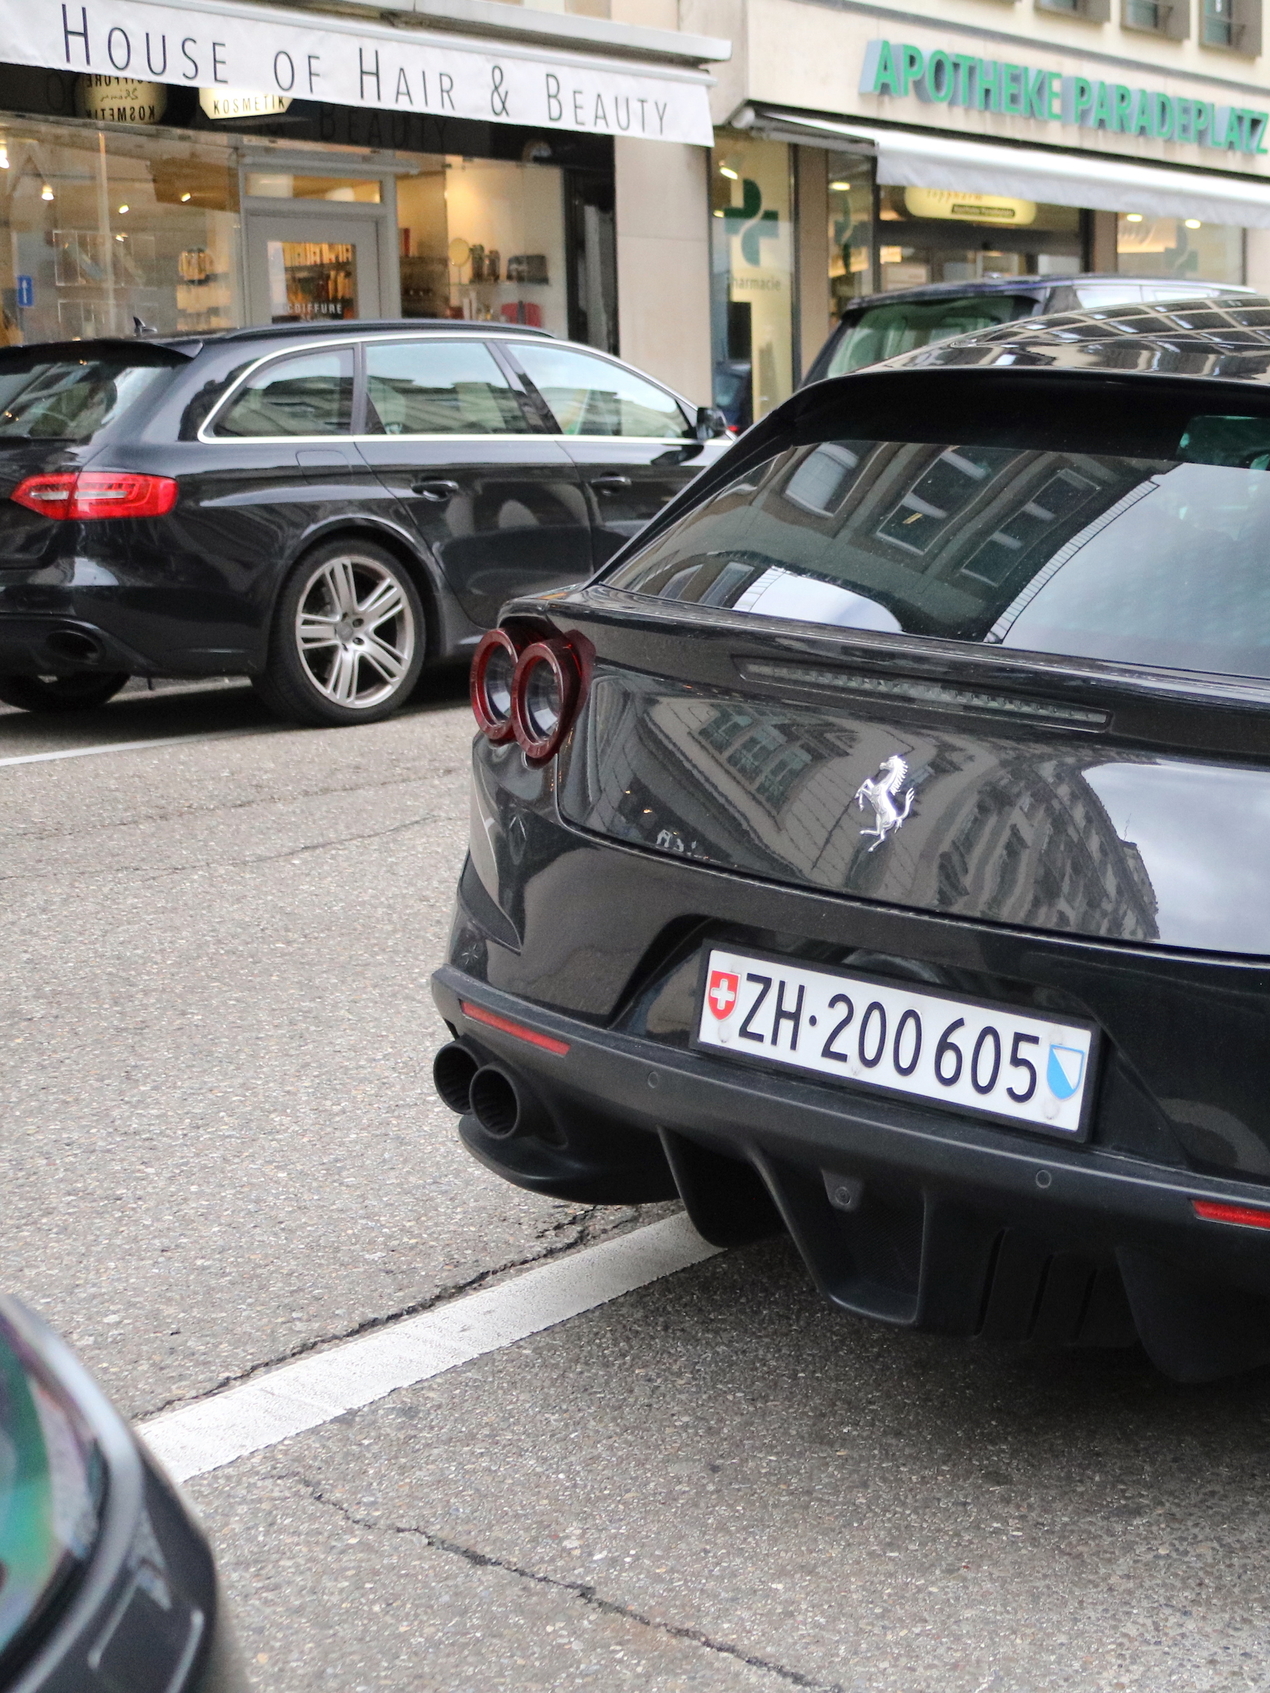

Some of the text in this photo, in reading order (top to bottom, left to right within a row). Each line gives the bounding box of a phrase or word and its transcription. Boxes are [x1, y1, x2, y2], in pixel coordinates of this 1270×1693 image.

[61, 3, 668, 136] HOUSE OF HAIR & BEAUTY
[868, 39, 1270, 155] APOTHEKE PARADEPLATZ
[212, 95, 286, 116] KOSMETIK
[287, 302, 343, 314] COIFFURE
